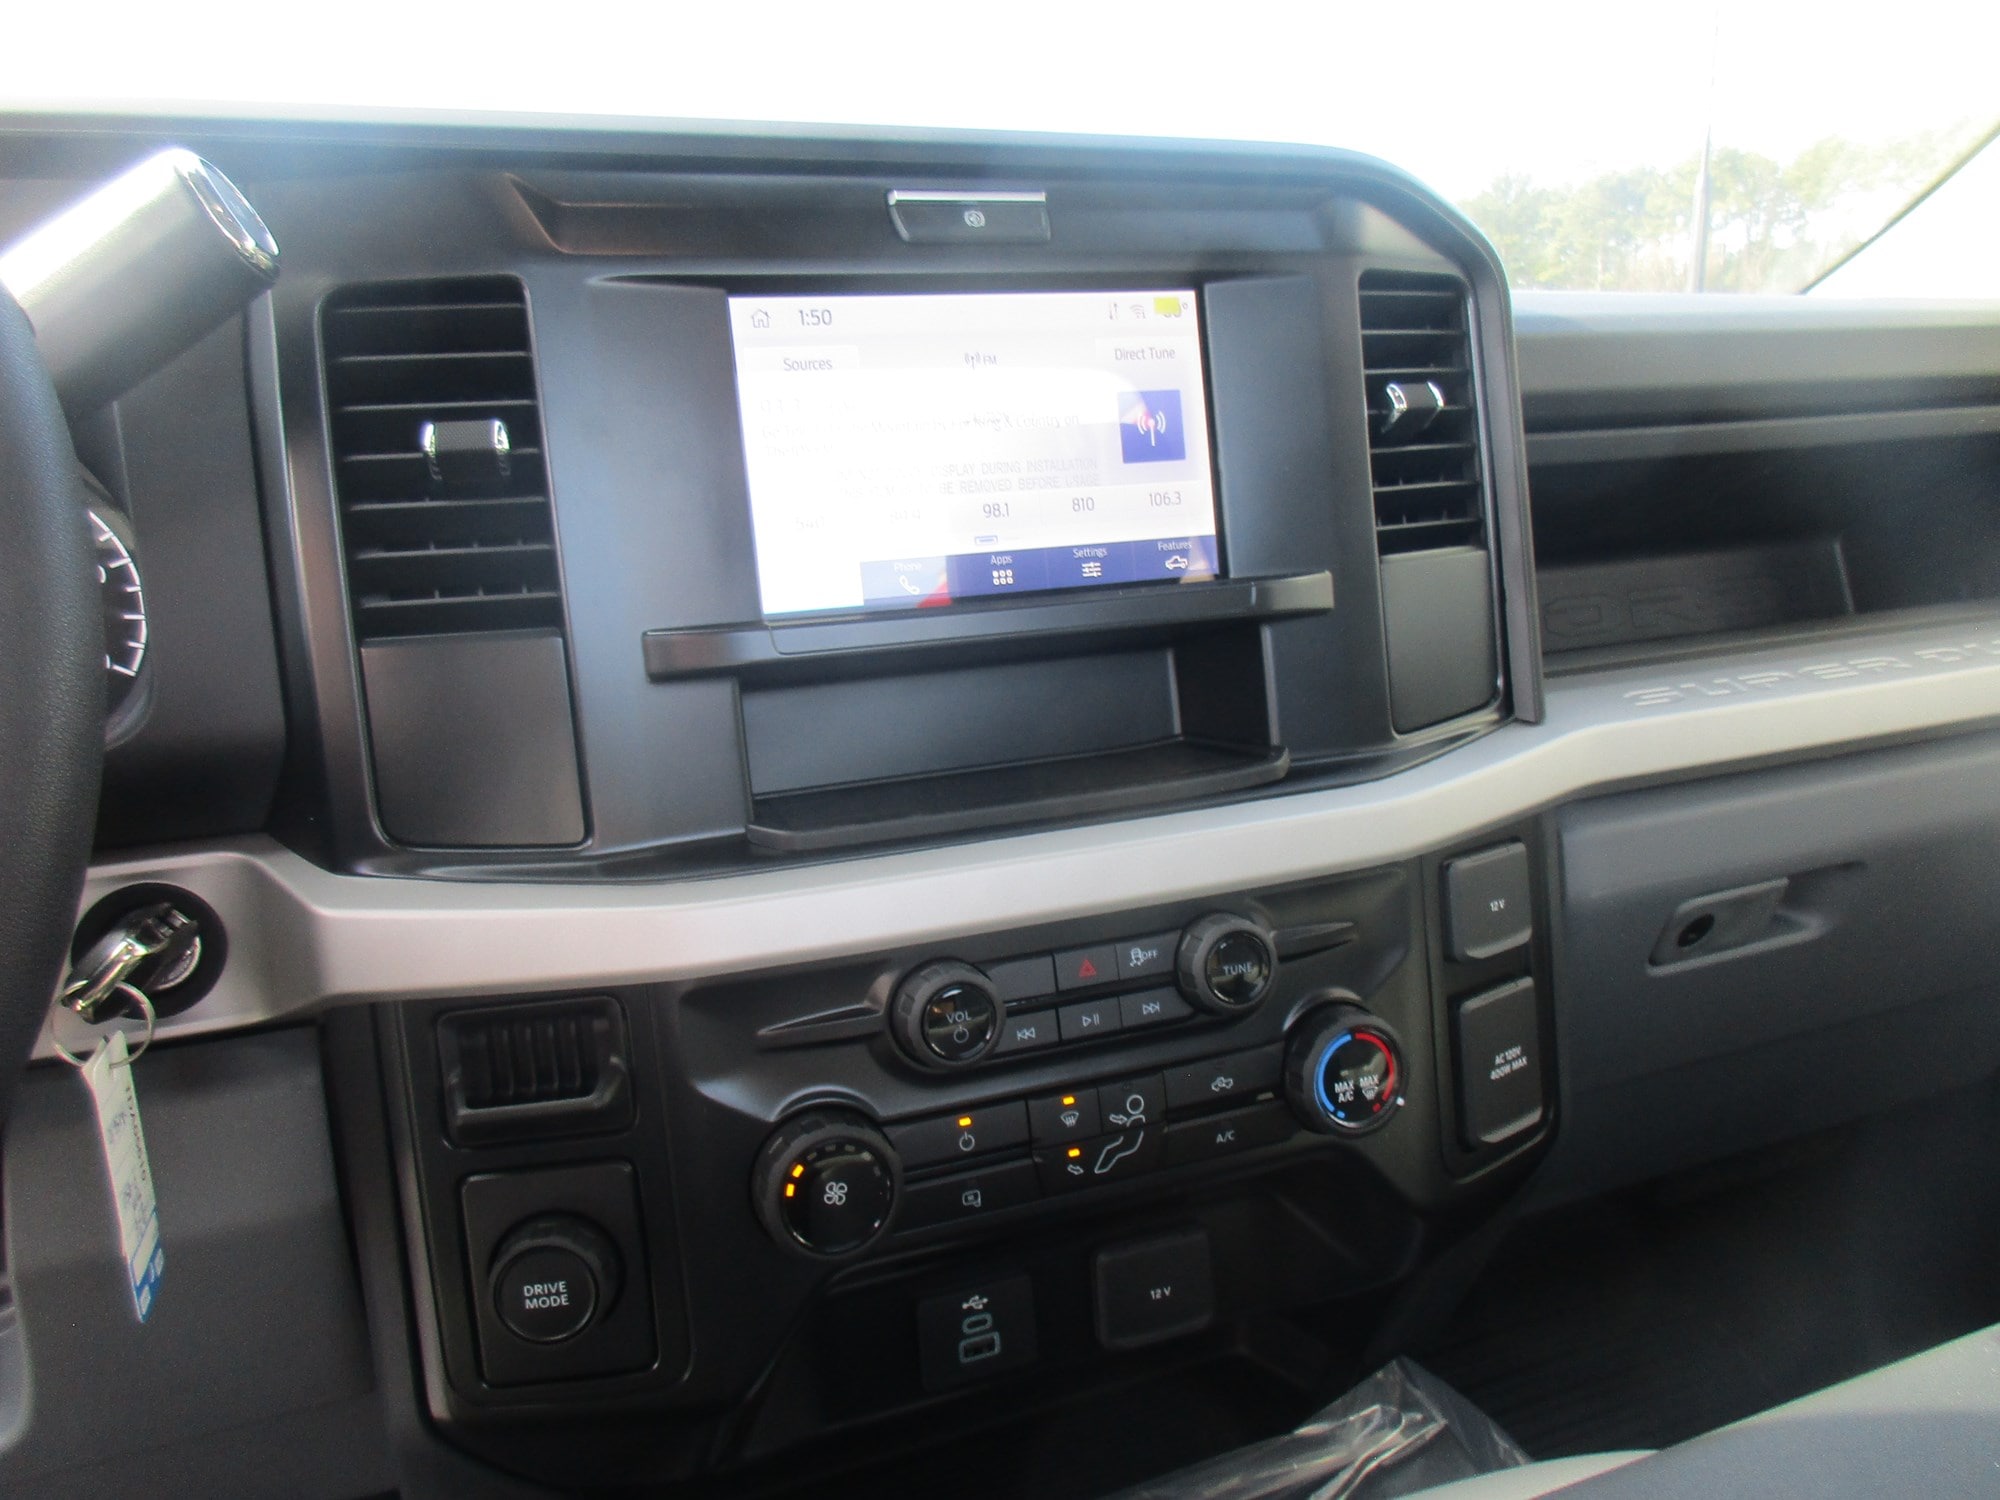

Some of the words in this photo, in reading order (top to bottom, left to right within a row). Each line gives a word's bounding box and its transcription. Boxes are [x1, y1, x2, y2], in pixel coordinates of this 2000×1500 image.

[798, 308, 833, 326] 1:50
[1114, 346, 1146, 361] Direct
[1148, 346, 1176, 360] Tune
[783, 357, 833, 372] Sources
[1064, 413, 1079, 426] on
[981, 461, 1021, 476] DURING
[1026, 457, 1098, 473] INSTALLATION
[960, 478, 1012, 494] REMOVED
[1018, 475, 1061, 490] BEFORE
[1072, 497, 1095, 512] 810
[1149, 492, 1182, 507] 106.3
[982, 503, 1010, 519] 98.1
[1073, 546, 1108, 559] Settings
[1157, 541, 1192, 552] Features
[990, 555, 1013, 567] Apps
[1623, 656, 1912, 706] SUPER
[1141, 949, 1158, 961] OFF
[1223, 962, 1253, 976] TUNE
[946, 1011, 972, 1024] VOL
[1334, 1080, 1354, 1094] MAX
[1360, 1074, 1379, 1088] MAX
[1216, 1130, 1236, 1144] A/C
[523, 1281, 567, 1297] DRIVE
[525, 1294, 569, 1310] MODE
